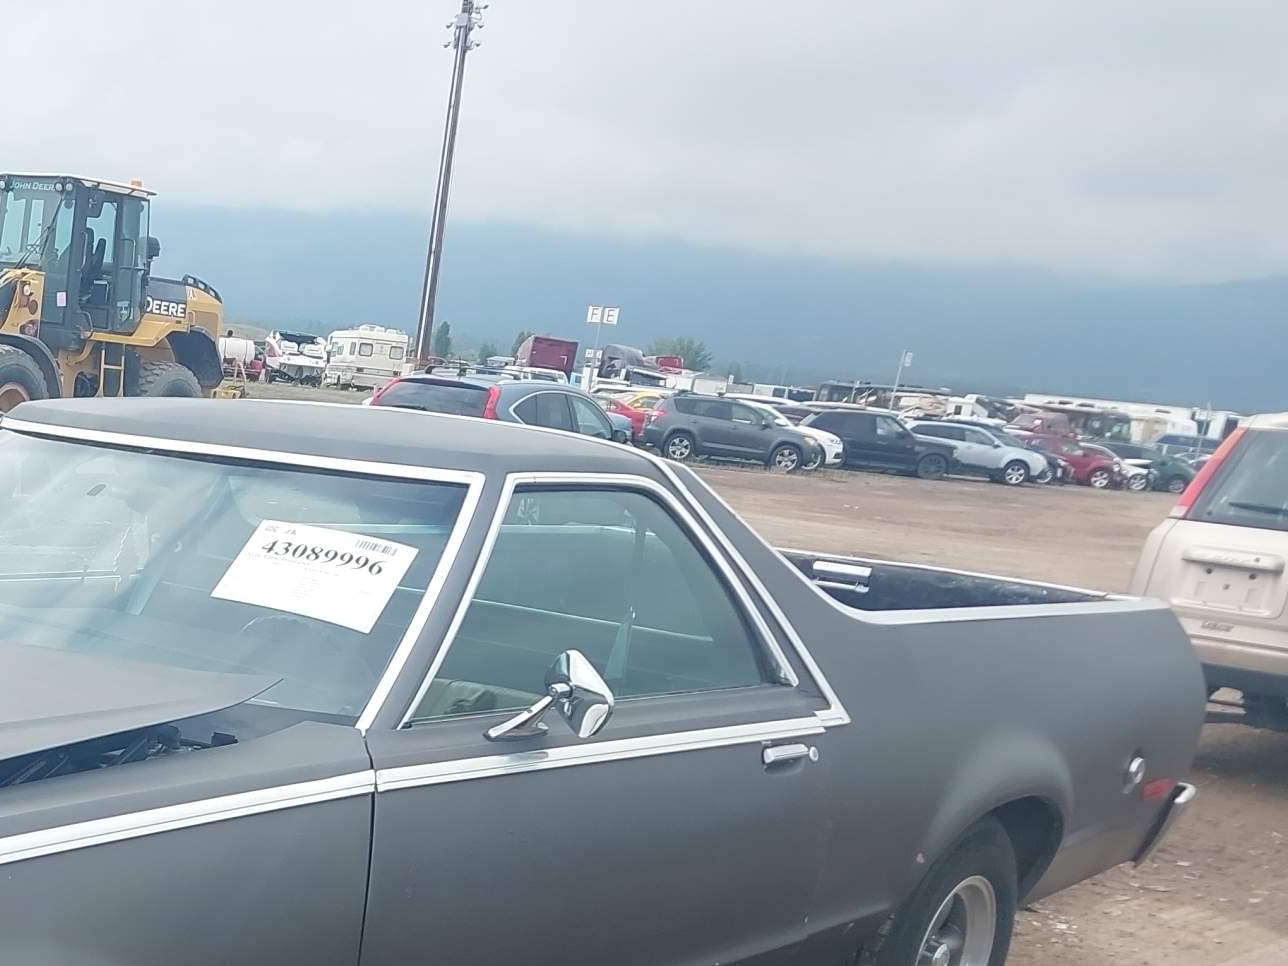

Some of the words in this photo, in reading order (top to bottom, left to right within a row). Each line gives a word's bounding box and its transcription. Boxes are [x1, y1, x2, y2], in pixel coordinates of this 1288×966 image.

[10, 180, 31, 190] JOHN
[32, 182, 55, 191] DEER
[591, 307, 600, 321] F
[607, 309, 616, 322] E
[261, 540, 387, 576] 43089996
